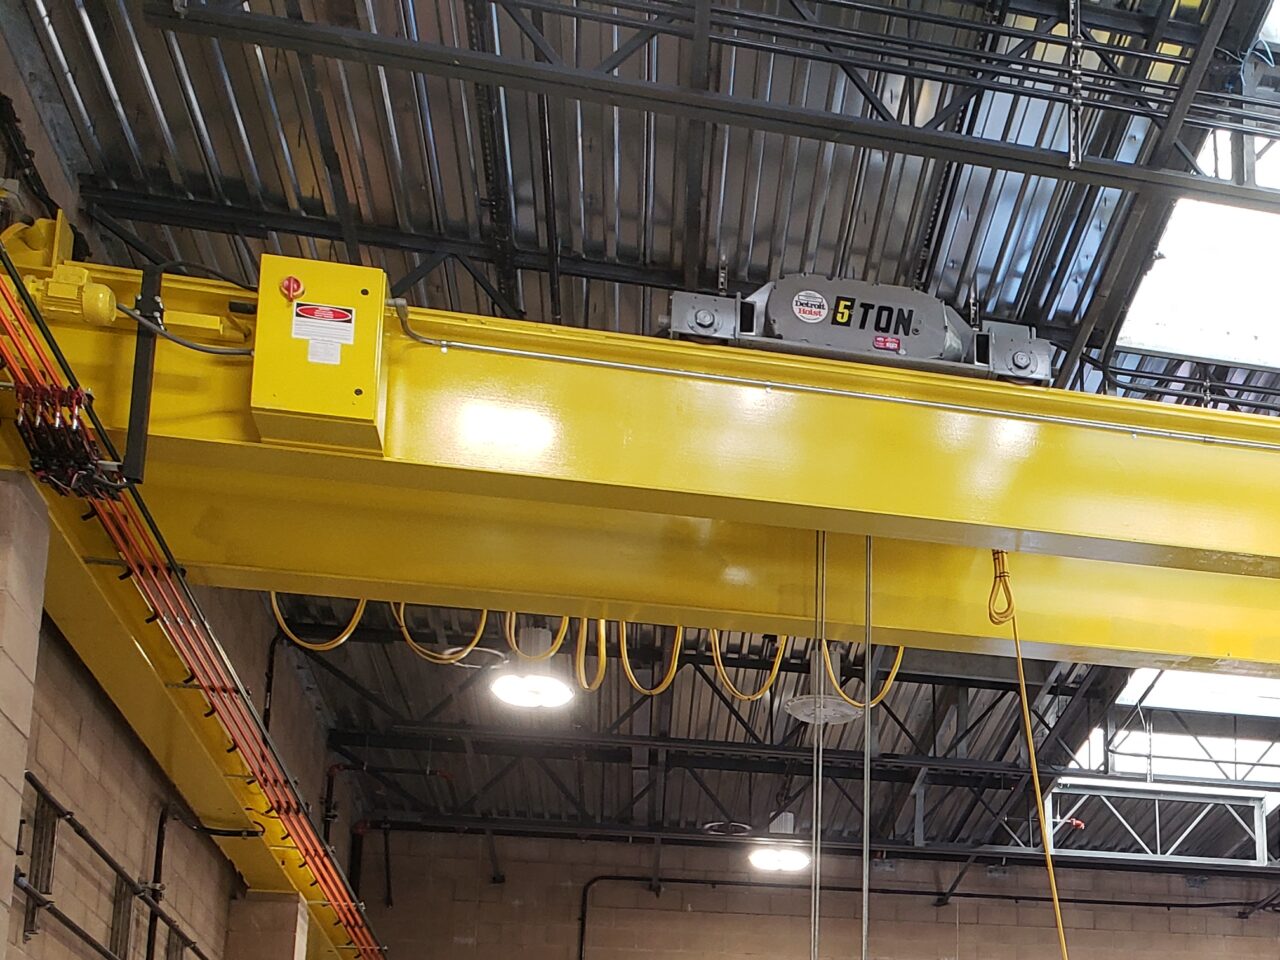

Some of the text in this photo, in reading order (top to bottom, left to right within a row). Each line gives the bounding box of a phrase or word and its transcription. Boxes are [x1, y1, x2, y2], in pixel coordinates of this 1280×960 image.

[795, 301, 826, 311] Detroit
[798, 308, 823, 317] Hoist
[836, 301, 914, 336] 5 TON
